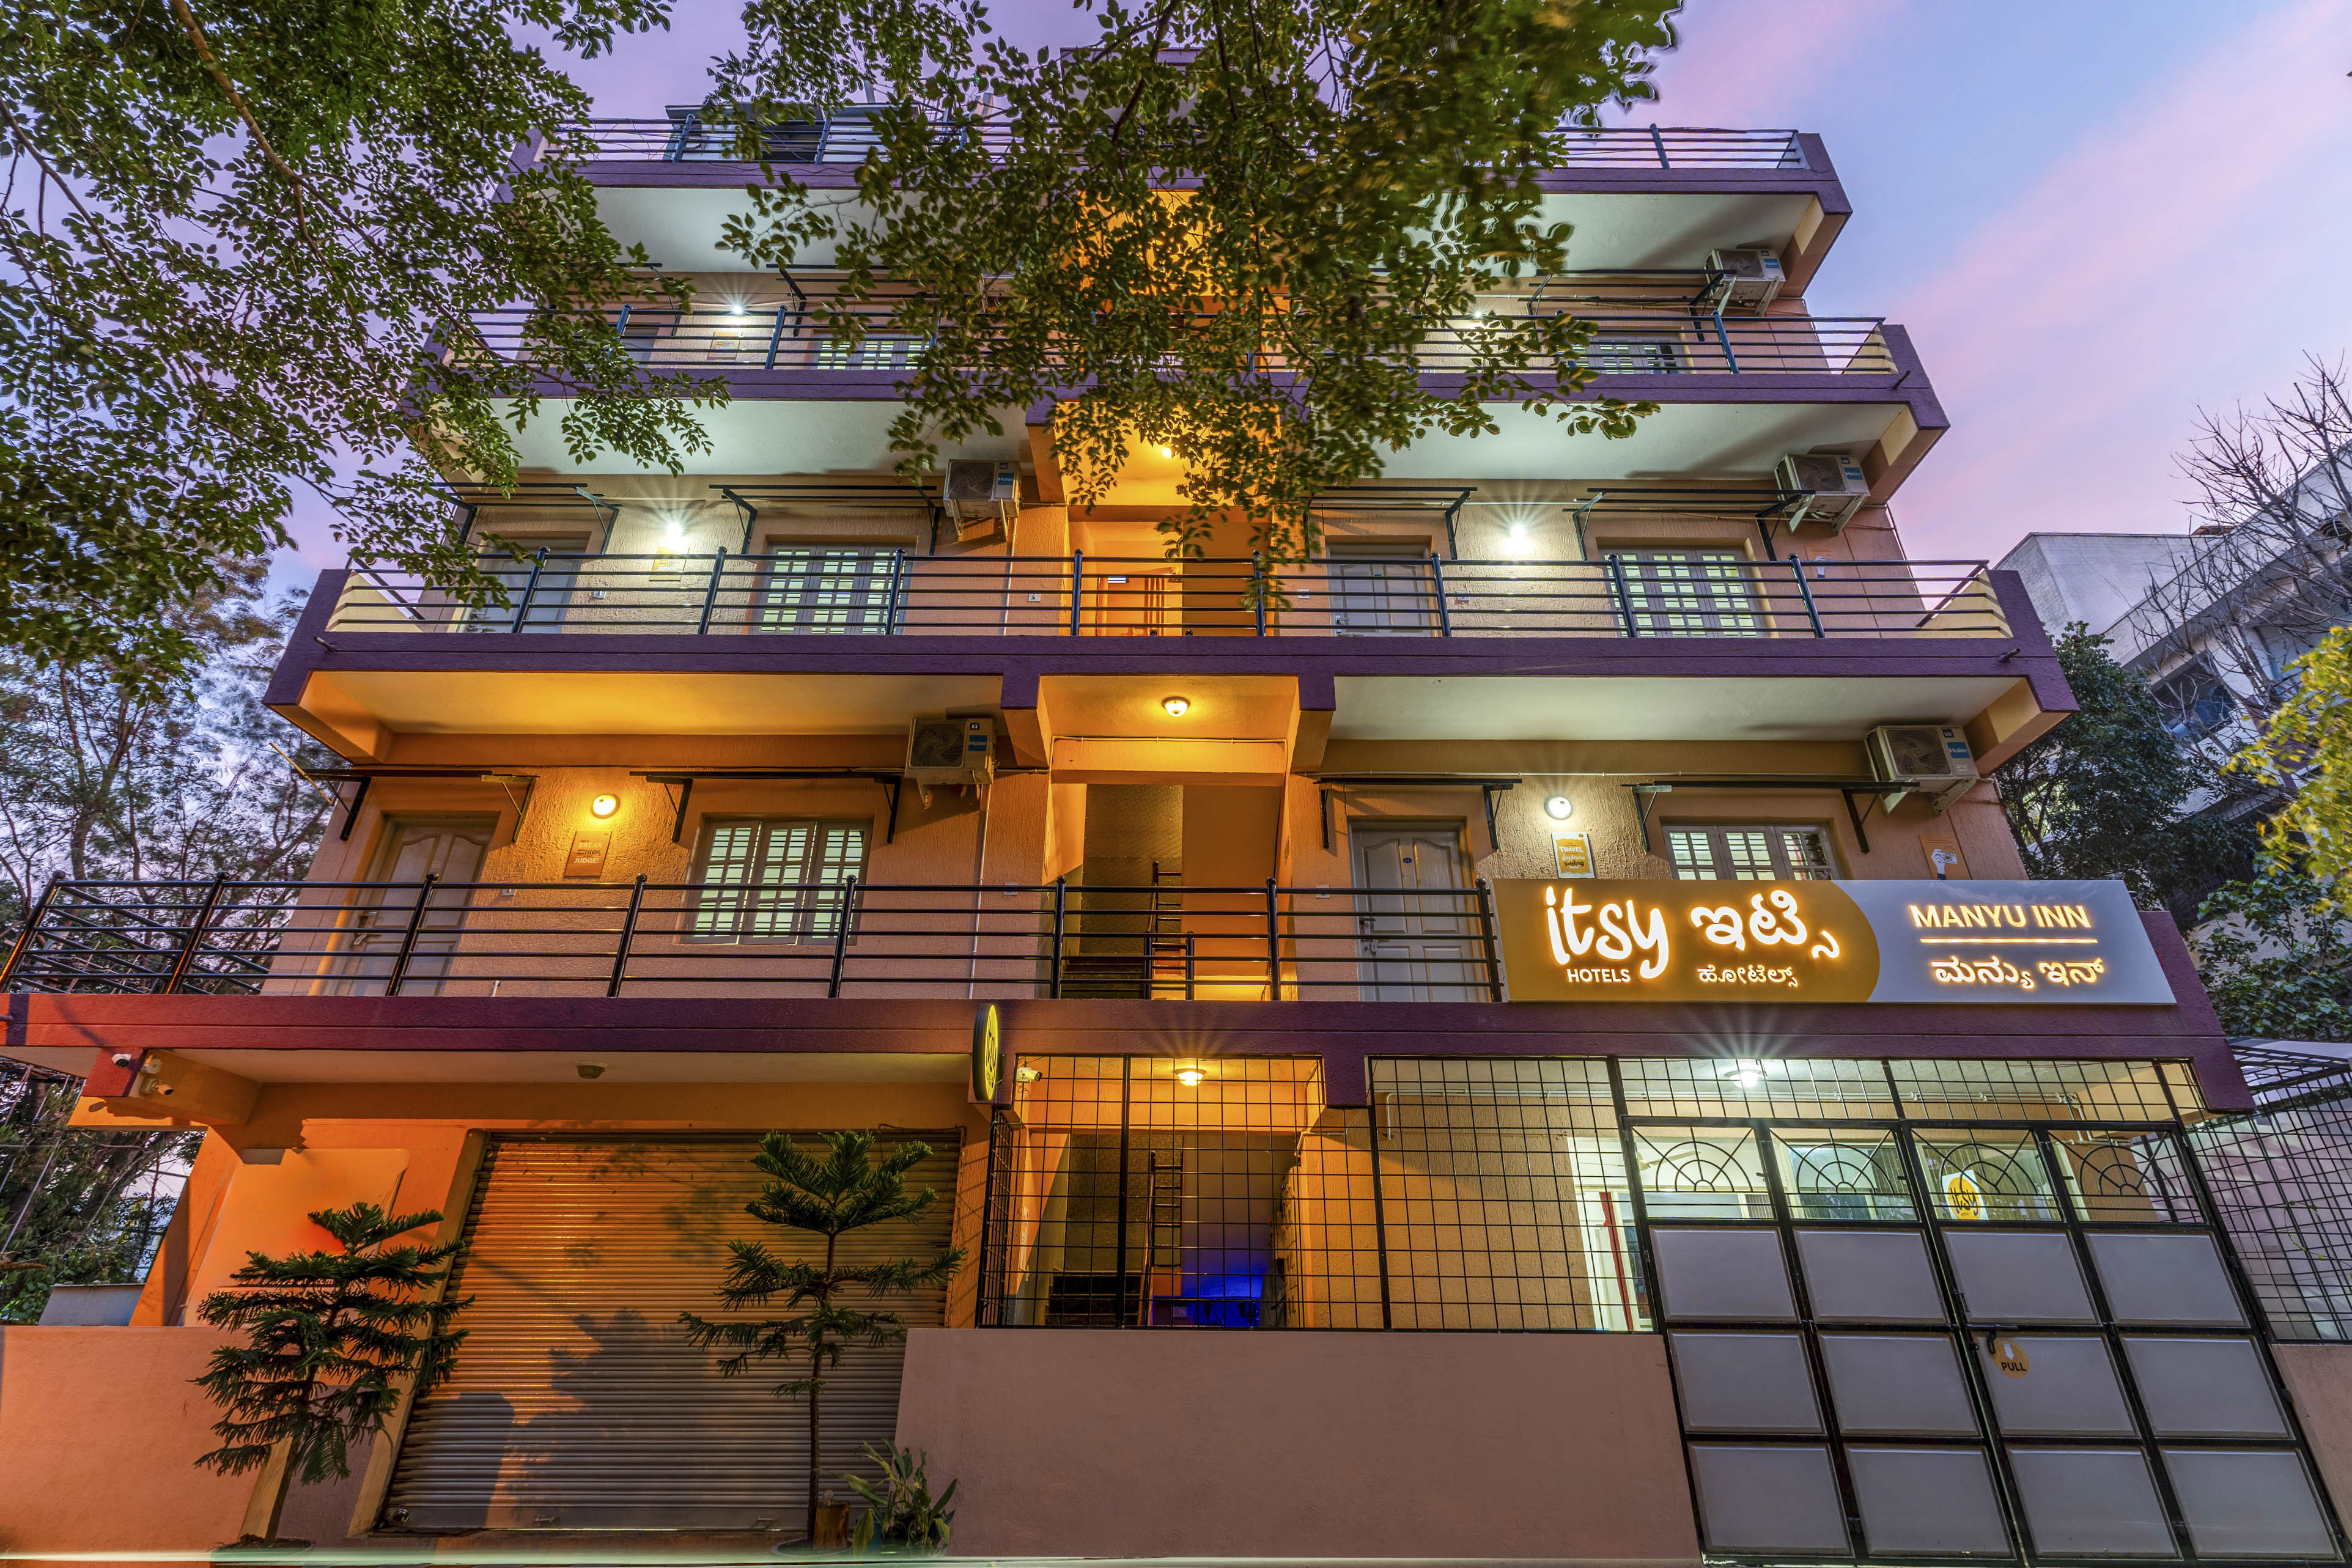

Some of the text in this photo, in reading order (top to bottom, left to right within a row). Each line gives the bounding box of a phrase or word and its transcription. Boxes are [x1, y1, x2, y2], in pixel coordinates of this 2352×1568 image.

[1909, 905, 2092, 928] MANYU INN
[1545, 886, 1669, 979] itsy
[1566, 968, 1631, 983] HOTELS
[2038, 957, 2104, 987] ಇನ್
[2001, 1361, 2027, 1372] PULL
